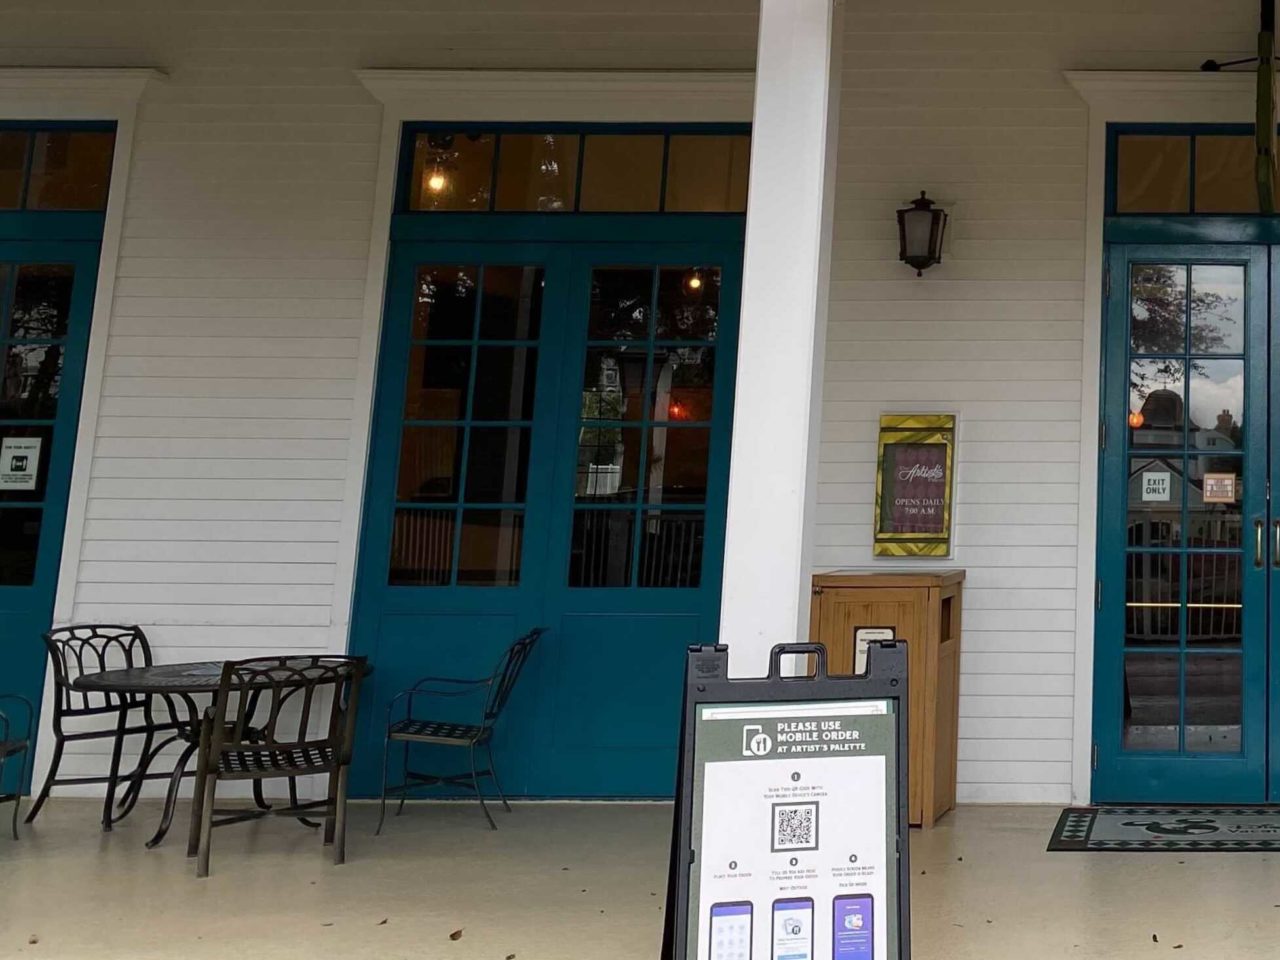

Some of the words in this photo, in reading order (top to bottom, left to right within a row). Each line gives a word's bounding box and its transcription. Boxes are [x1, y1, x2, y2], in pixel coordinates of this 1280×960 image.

[1147, 478, 1166, 486] EXIT
[1145, 486, 1167, 495] ONLY
[895, 497, 920, 506] OPENS
[922, 498, 945, 506] DAILY
[777, 722, 818, 732] PLEASE
[821, 721, 841, 731] USE
[777, 731, 819, 742] MOBILE
[822, 730, 860, 740] ORDER
[777, 745, 788, 753] AT
[791, 743, 828, 753] ARTIST'S
[830, 742, 866, 752] PALETTE
